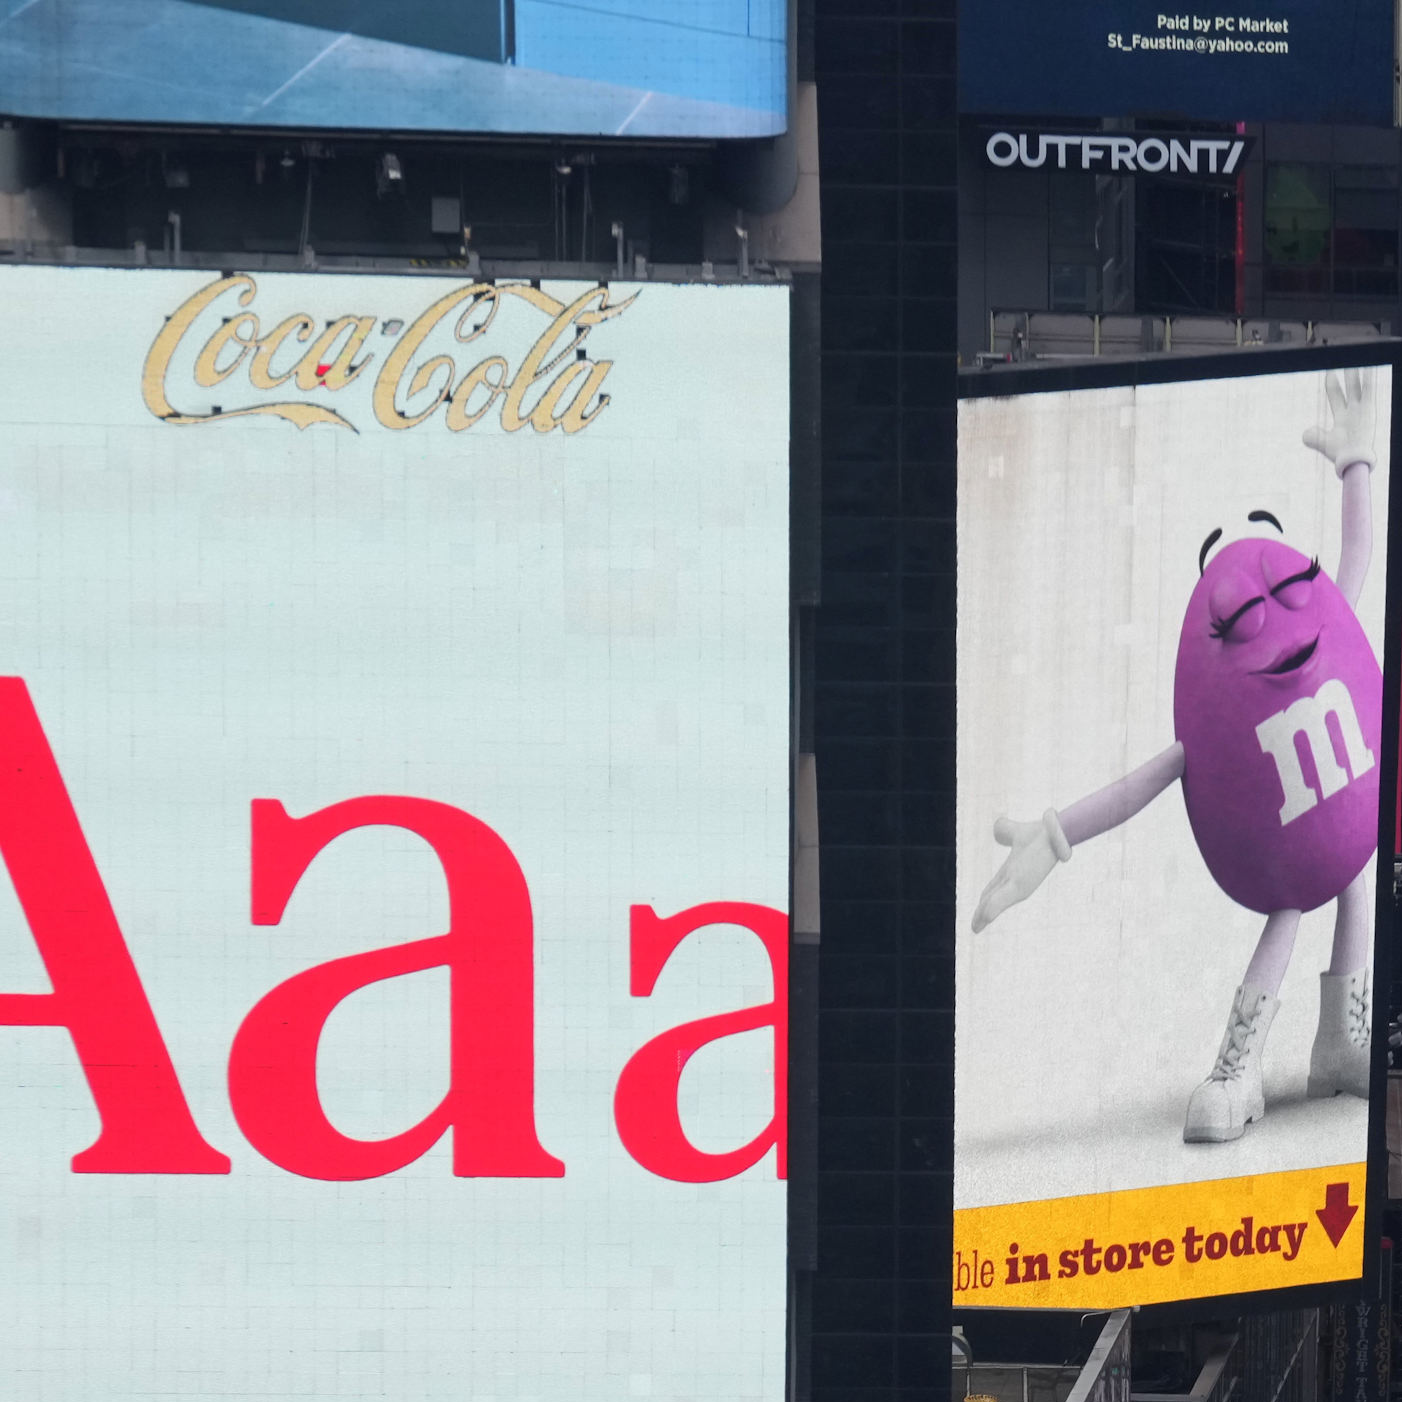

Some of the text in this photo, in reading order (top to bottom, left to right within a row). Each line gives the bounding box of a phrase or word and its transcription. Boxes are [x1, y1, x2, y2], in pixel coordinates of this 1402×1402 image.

[1107, 34, 1289, 55] St_Faustina@yahoo.com
[1157, 15, 1289, 34] Paid by PC Market
[1254, 676, 1377, 828] m
[1005, 1243, 1050, 1285] in
[1058, 1236, 1175, 1280] store
[1182, 1216, 1308, 1263] today
